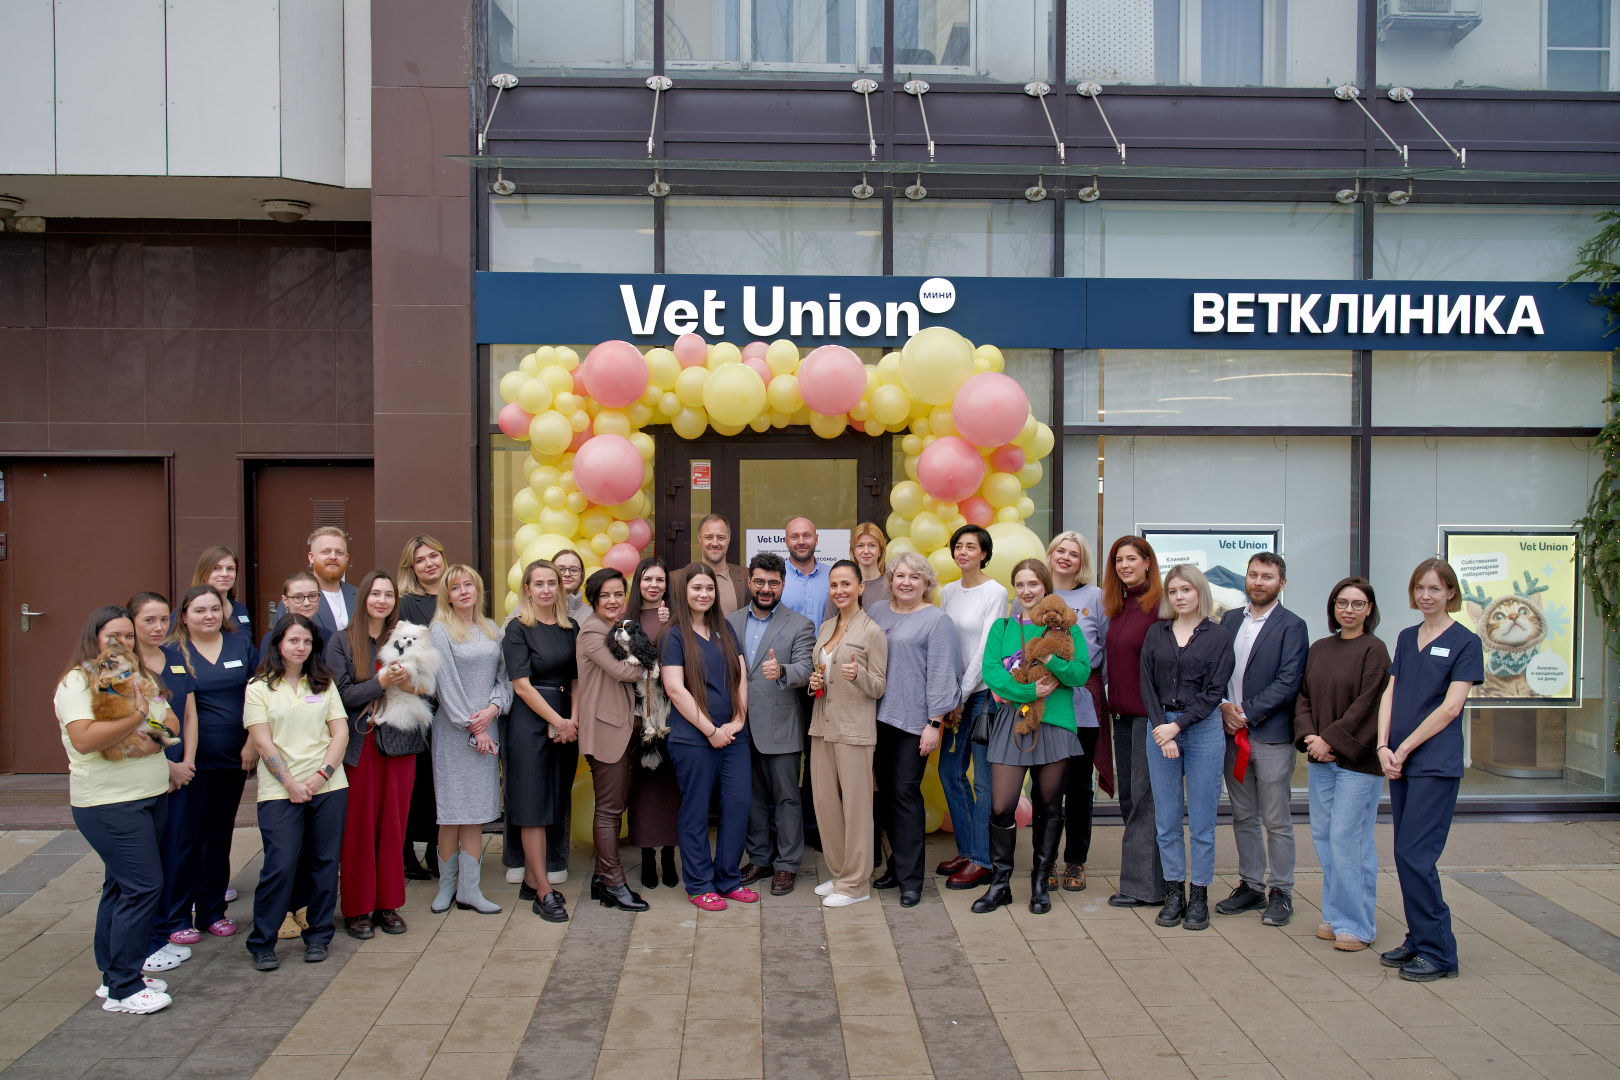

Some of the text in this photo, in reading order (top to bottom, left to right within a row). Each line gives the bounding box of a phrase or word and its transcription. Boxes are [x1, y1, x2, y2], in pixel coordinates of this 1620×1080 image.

[619, 284, 920, 337] Vet Union
[1193, 292, 1545, 335] ВЕТКЛИНИКА
[757, 535, 772, 543] Vet
[1219, 539, 1268, 550] Vet Union
[1519, 542, 1568, 551] Vet Union
